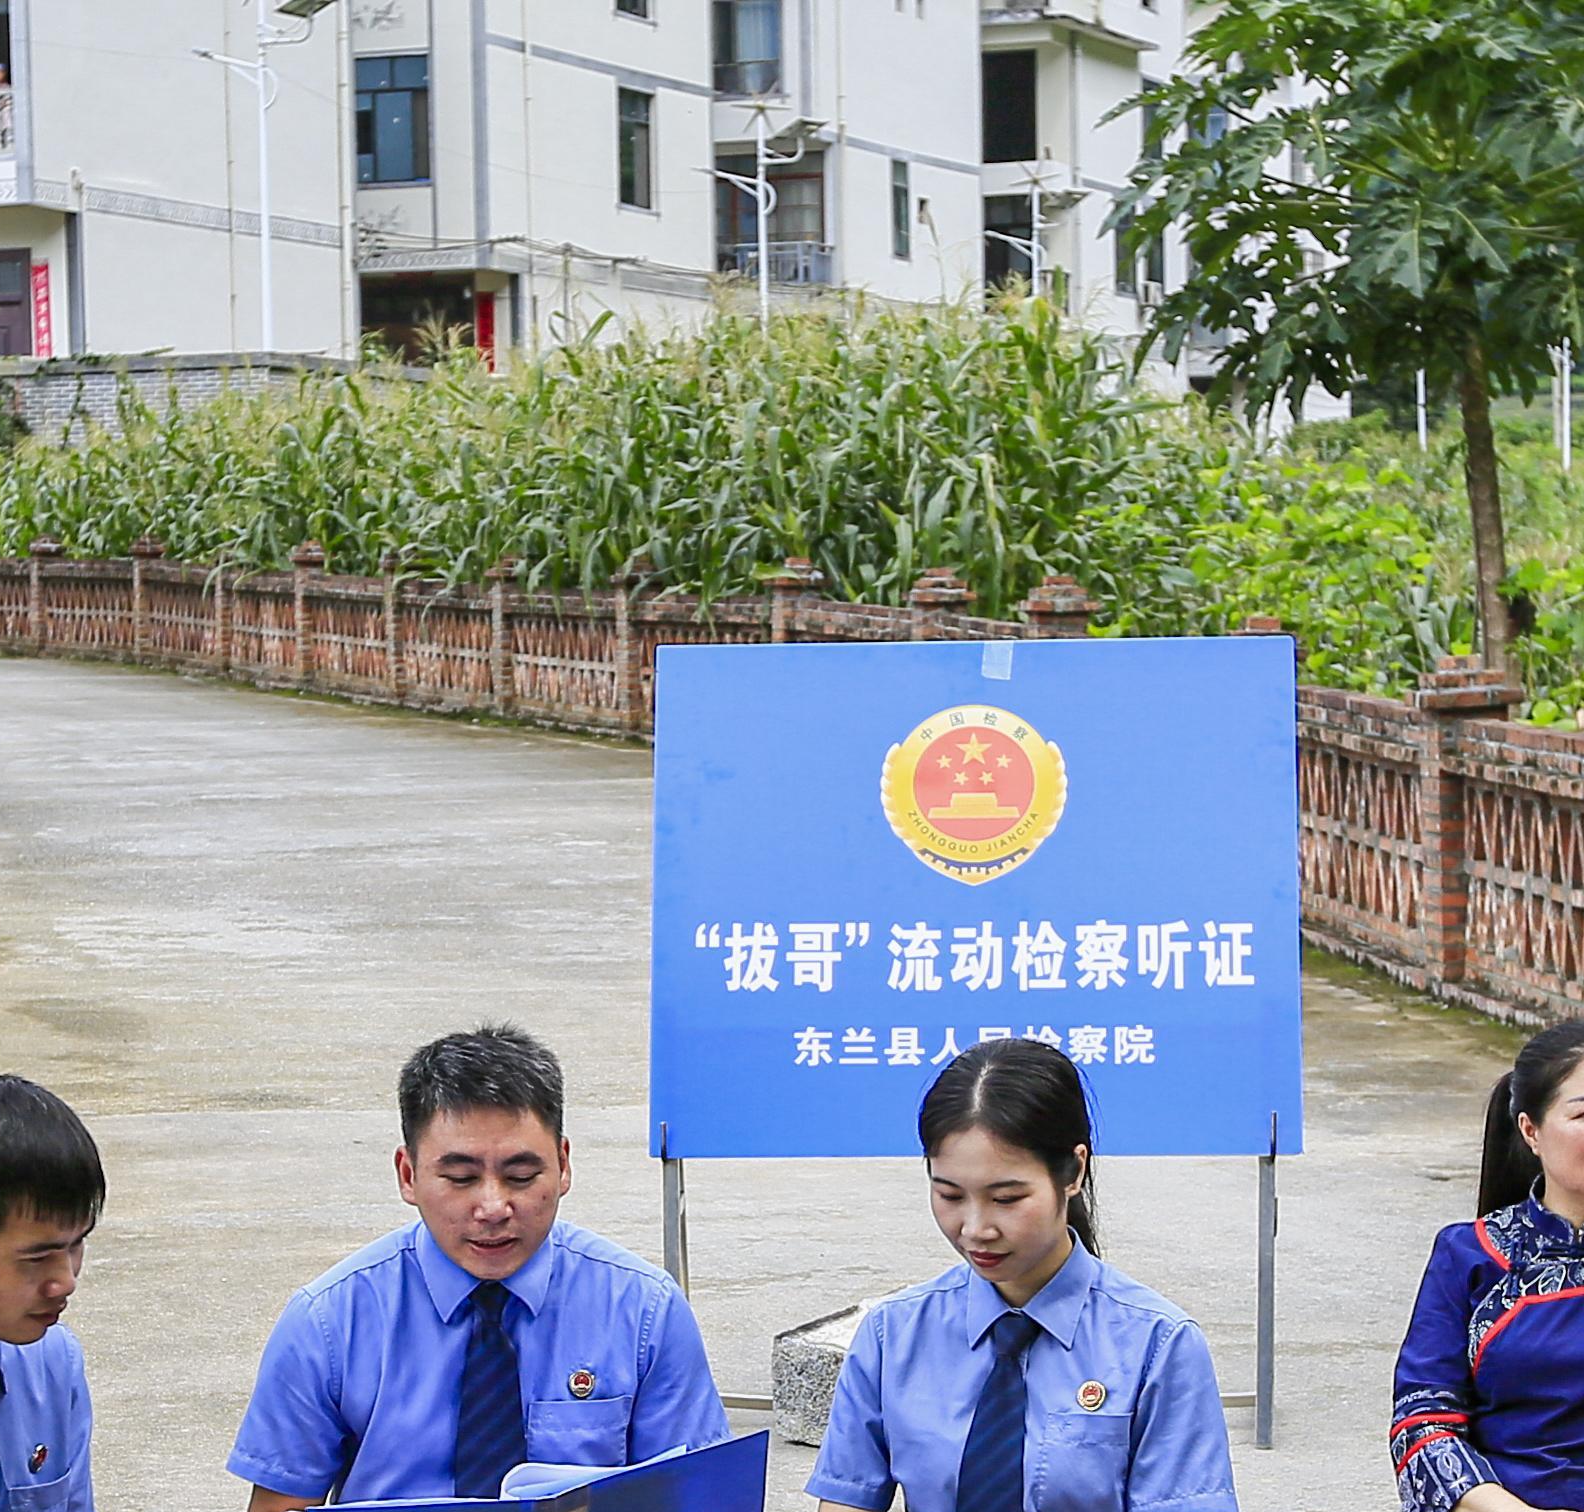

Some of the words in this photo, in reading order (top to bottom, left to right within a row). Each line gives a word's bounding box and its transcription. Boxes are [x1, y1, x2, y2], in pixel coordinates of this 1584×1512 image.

[921, 712, 1028, 741] 中国检察
[908, 810, 979, 853] ZHONGGUO
[986, 812, 1039, 853] JIANCHA
[695, 919, 1256, 992] “拔哥”流动检察听证
